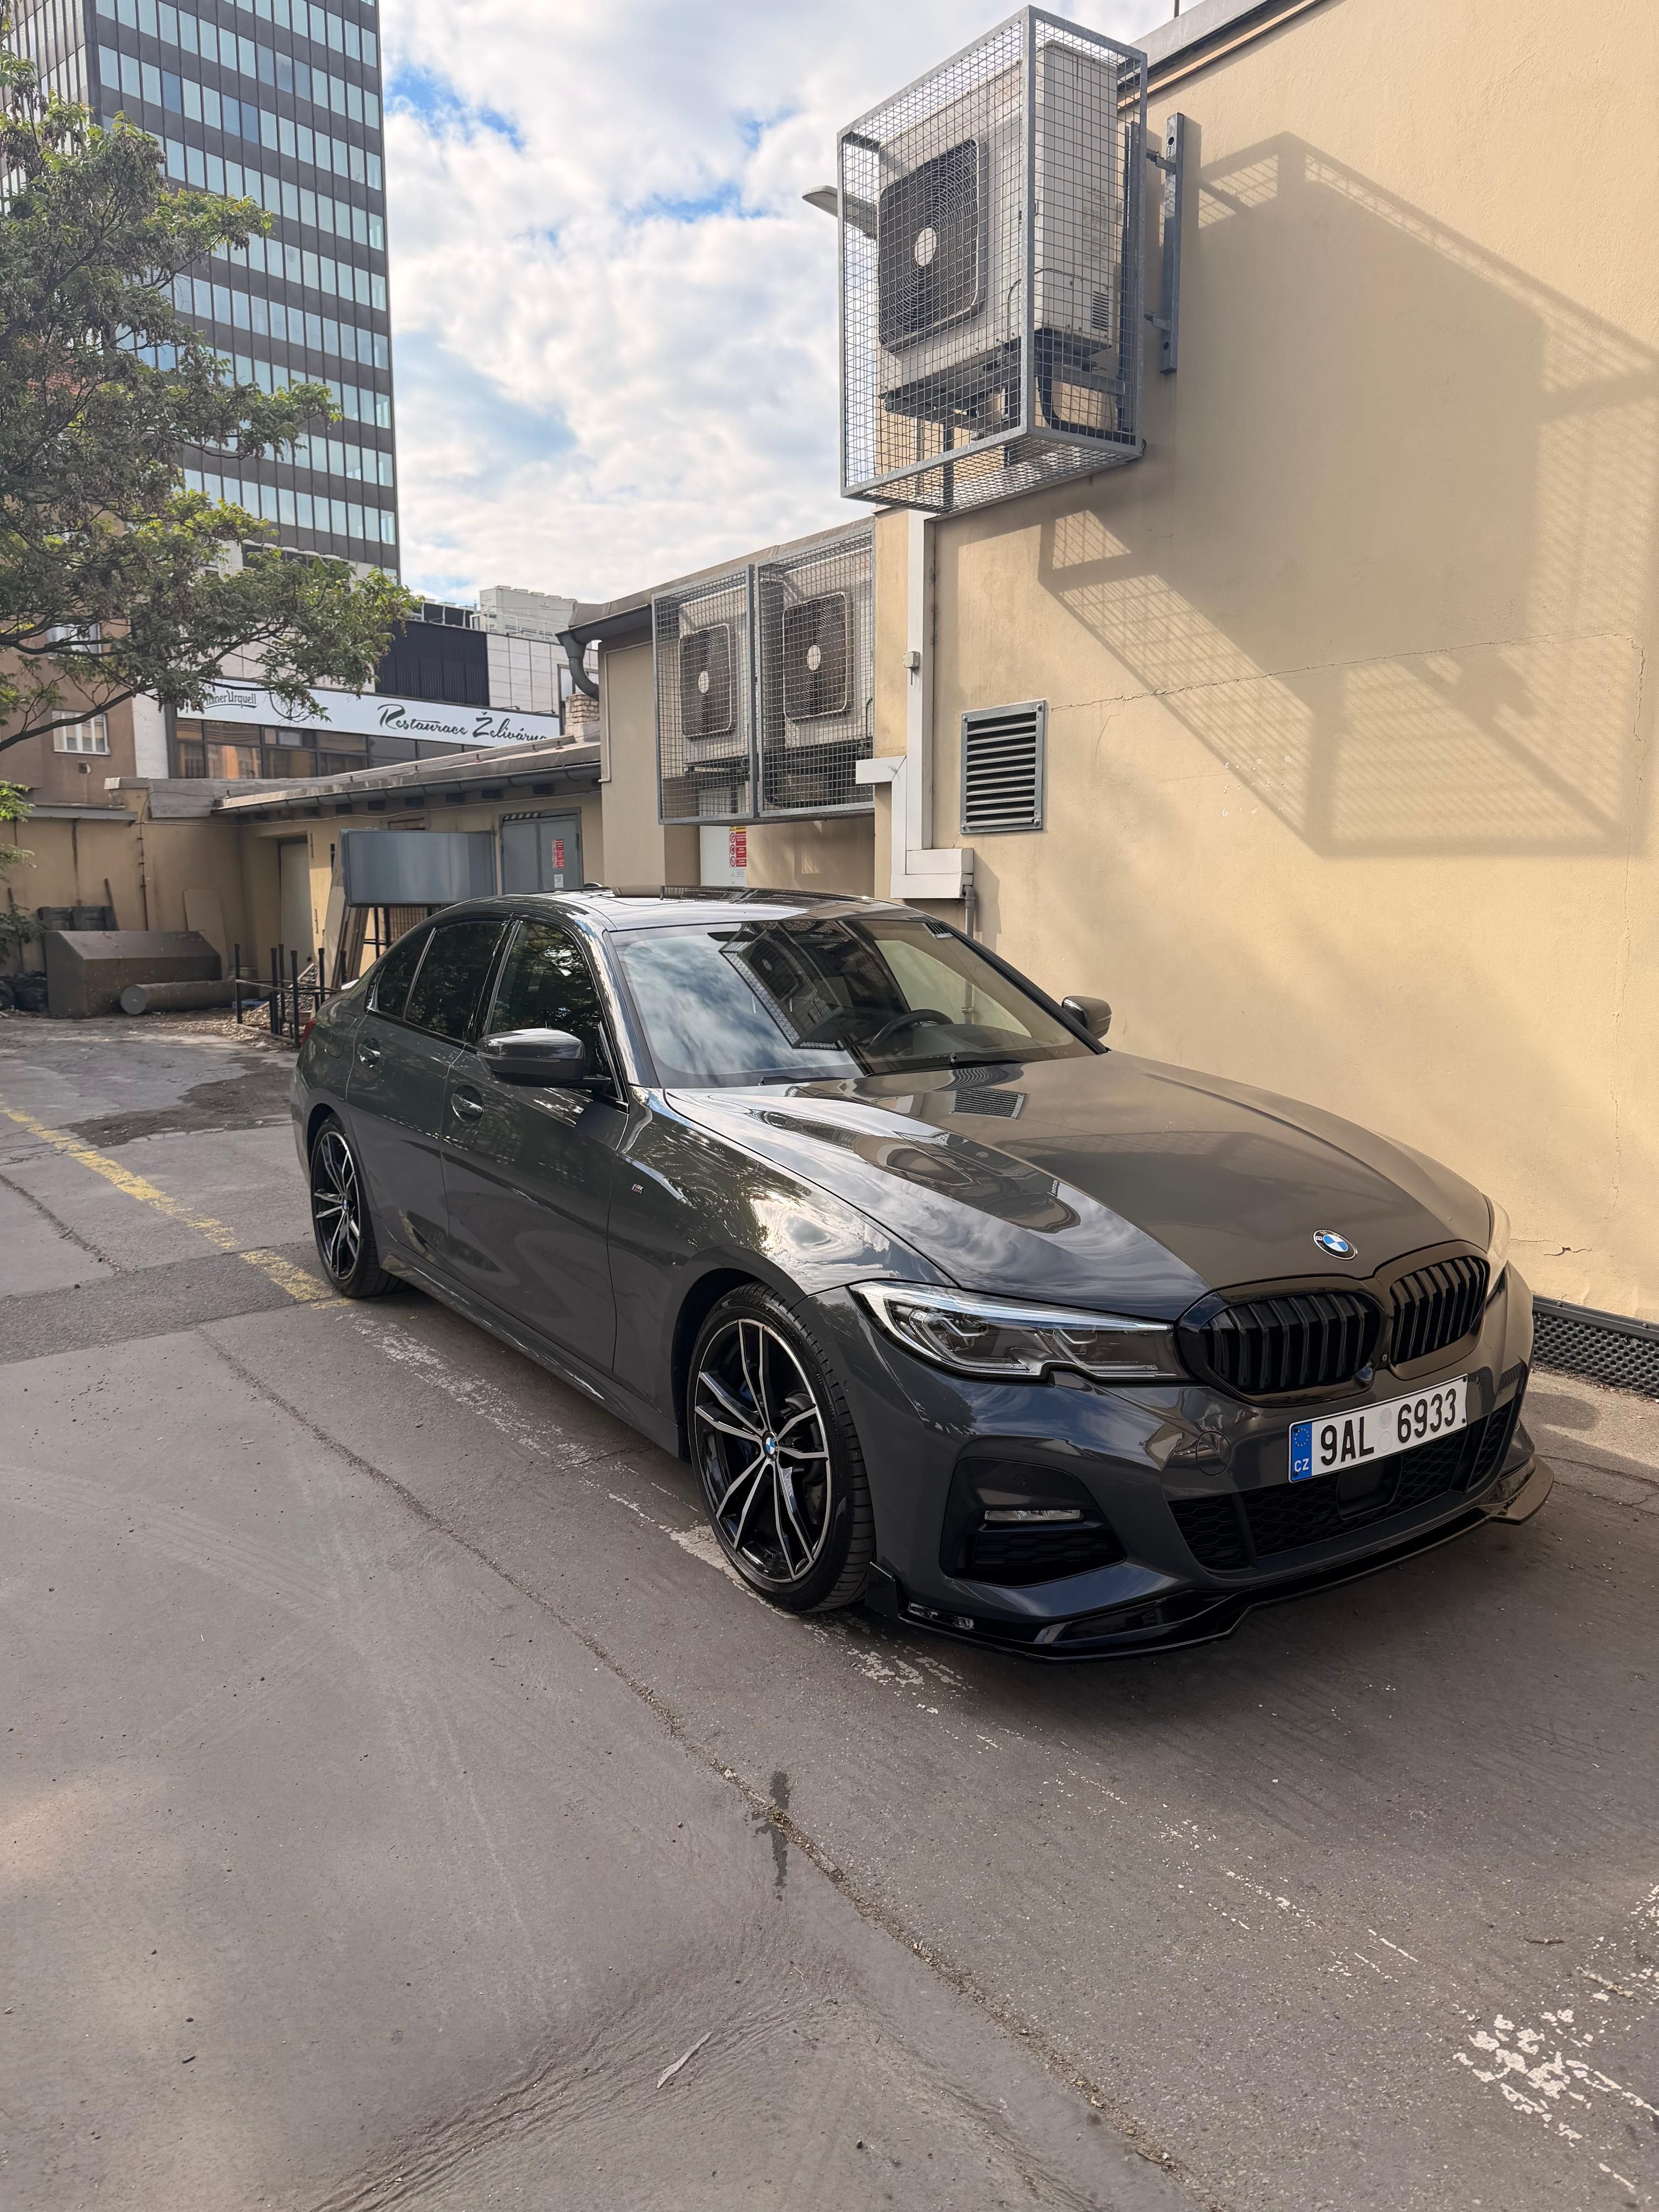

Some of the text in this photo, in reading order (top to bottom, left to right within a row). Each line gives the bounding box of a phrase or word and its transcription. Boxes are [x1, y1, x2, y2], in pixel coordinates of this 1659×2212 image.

[226, 690, 257, 708] Urquell
[377, 704, 469, 736] Restaurace
[1320, 1388, 1457, 1466] 9AL 6933
[1294, 1458, 1309, 1473] CZ
